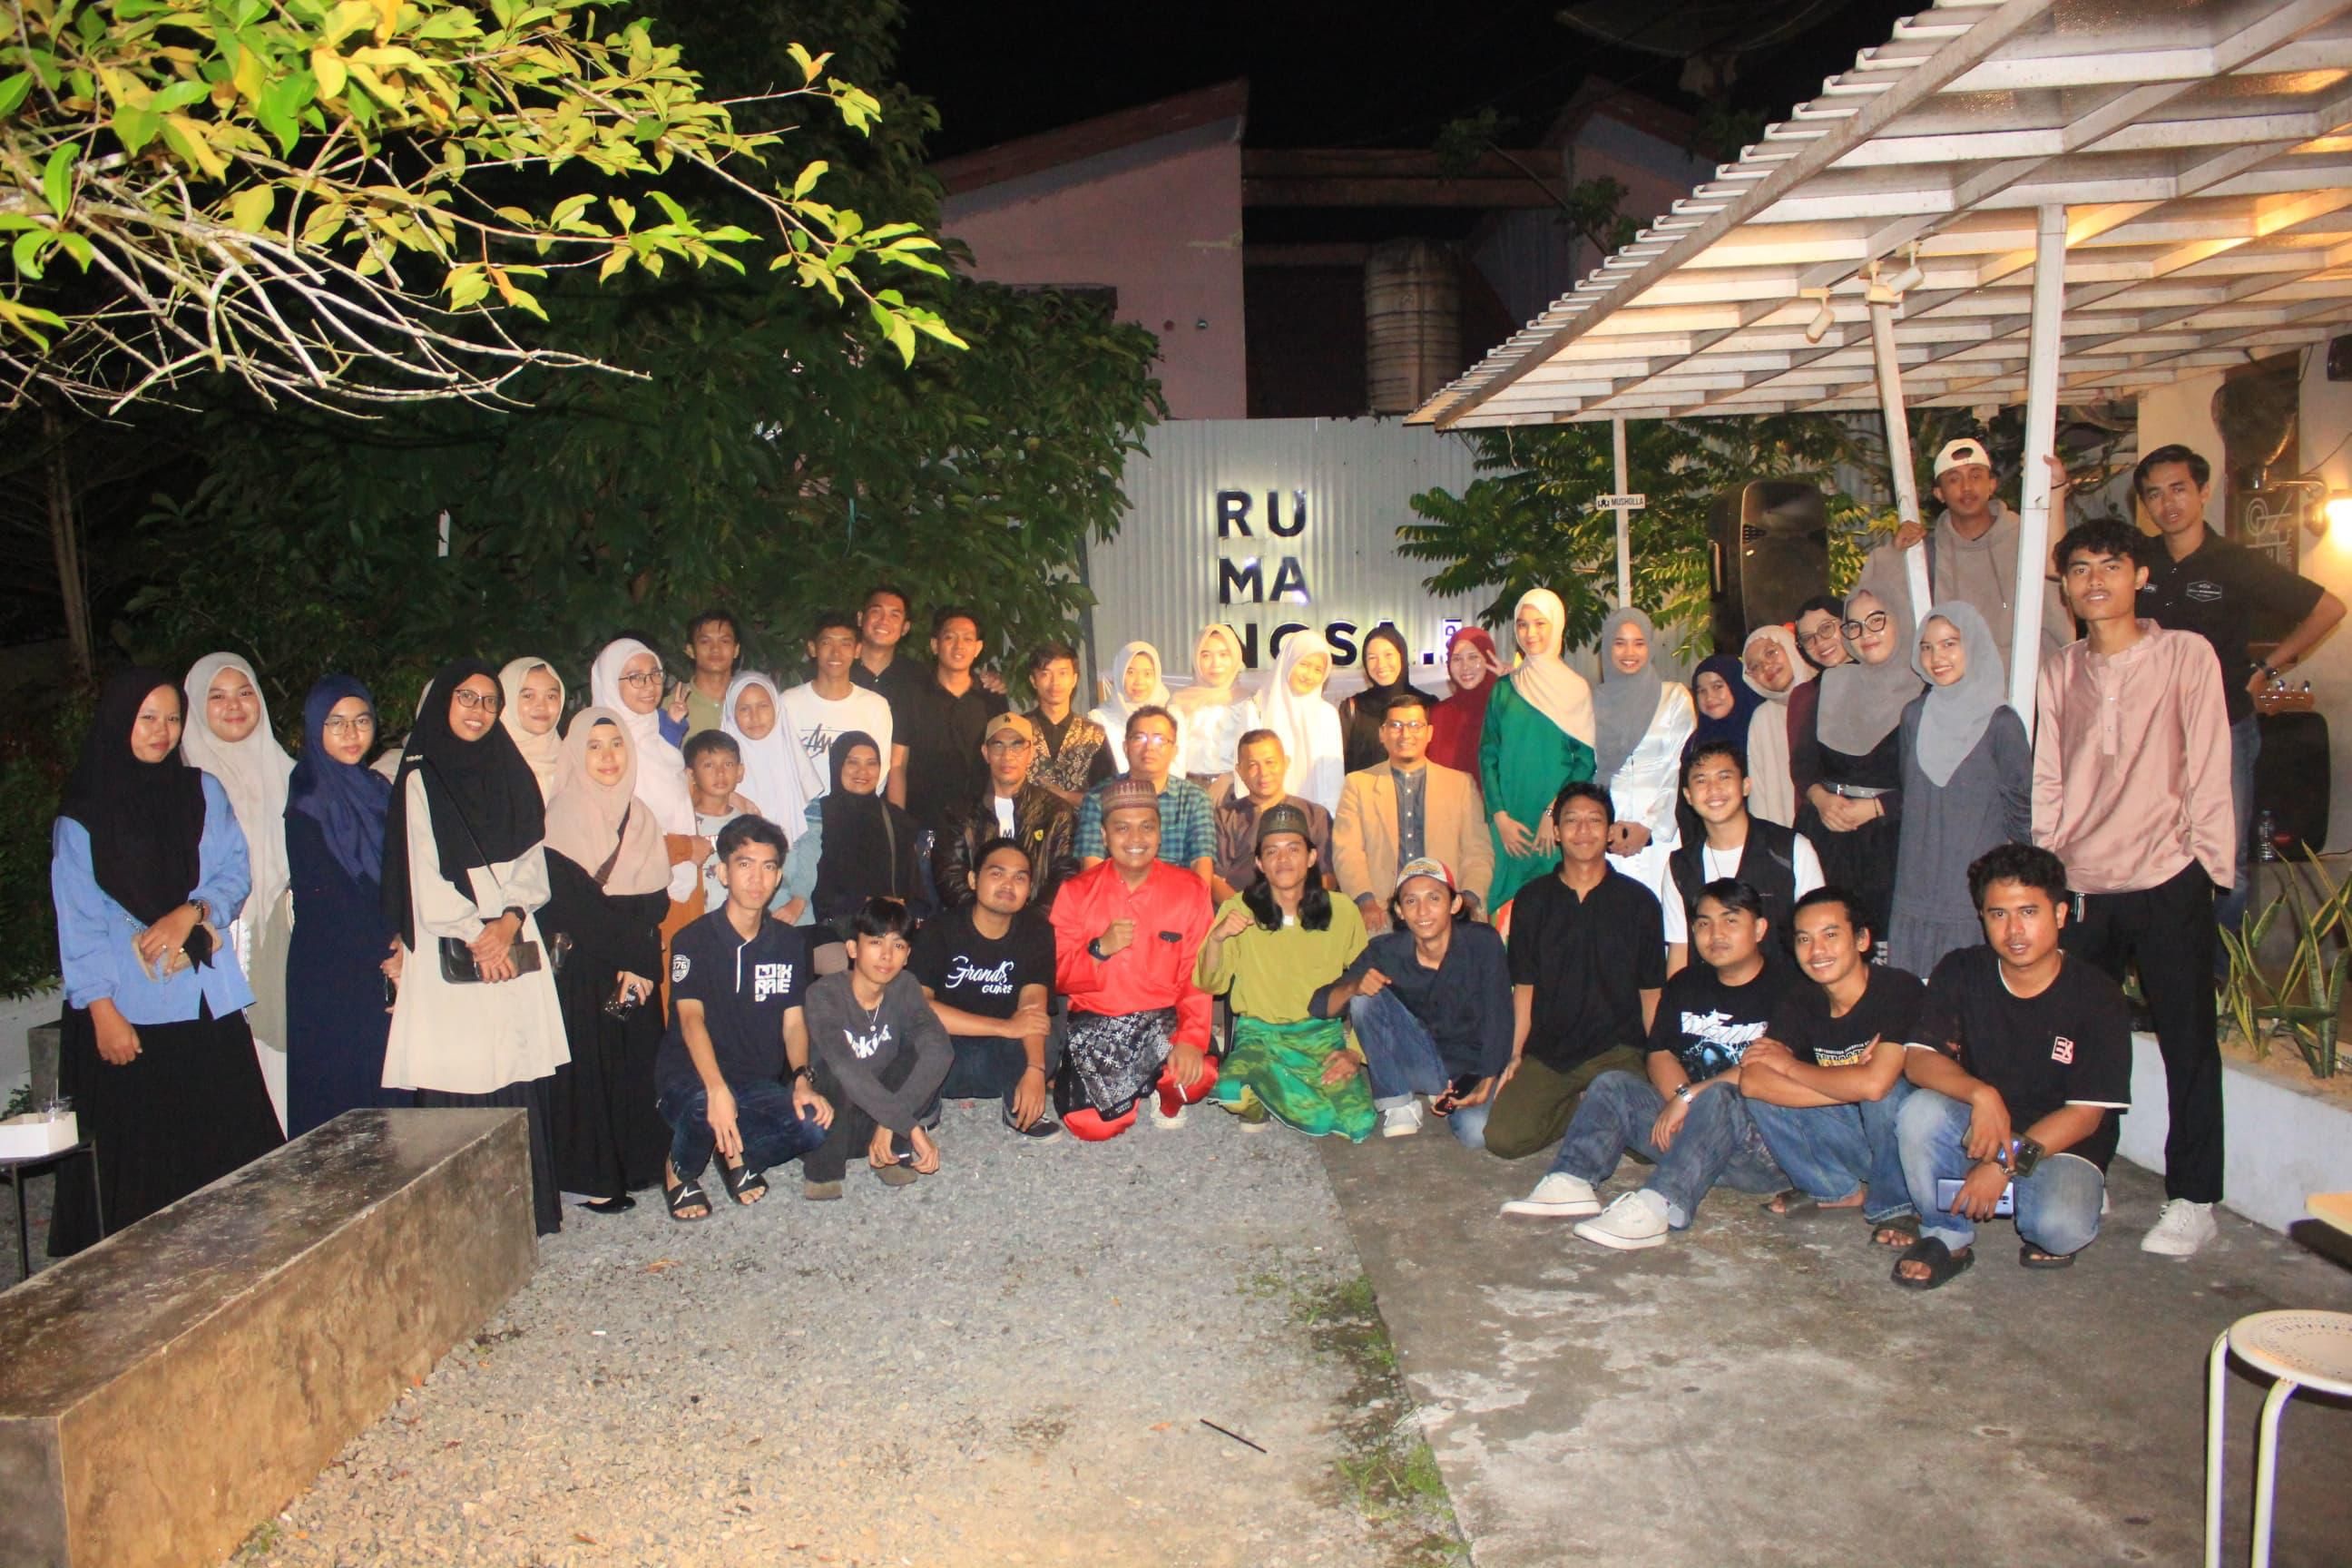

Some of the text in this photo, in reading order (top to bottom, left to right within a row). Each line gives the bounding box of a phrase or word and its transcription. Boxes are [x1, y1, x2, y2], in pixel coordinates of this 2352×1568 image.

[1217, 490, 1307, 537] RU
[1611, 496, 1643, 506] MUSHOLLA
[1218, 556, 1312, 604] MA
